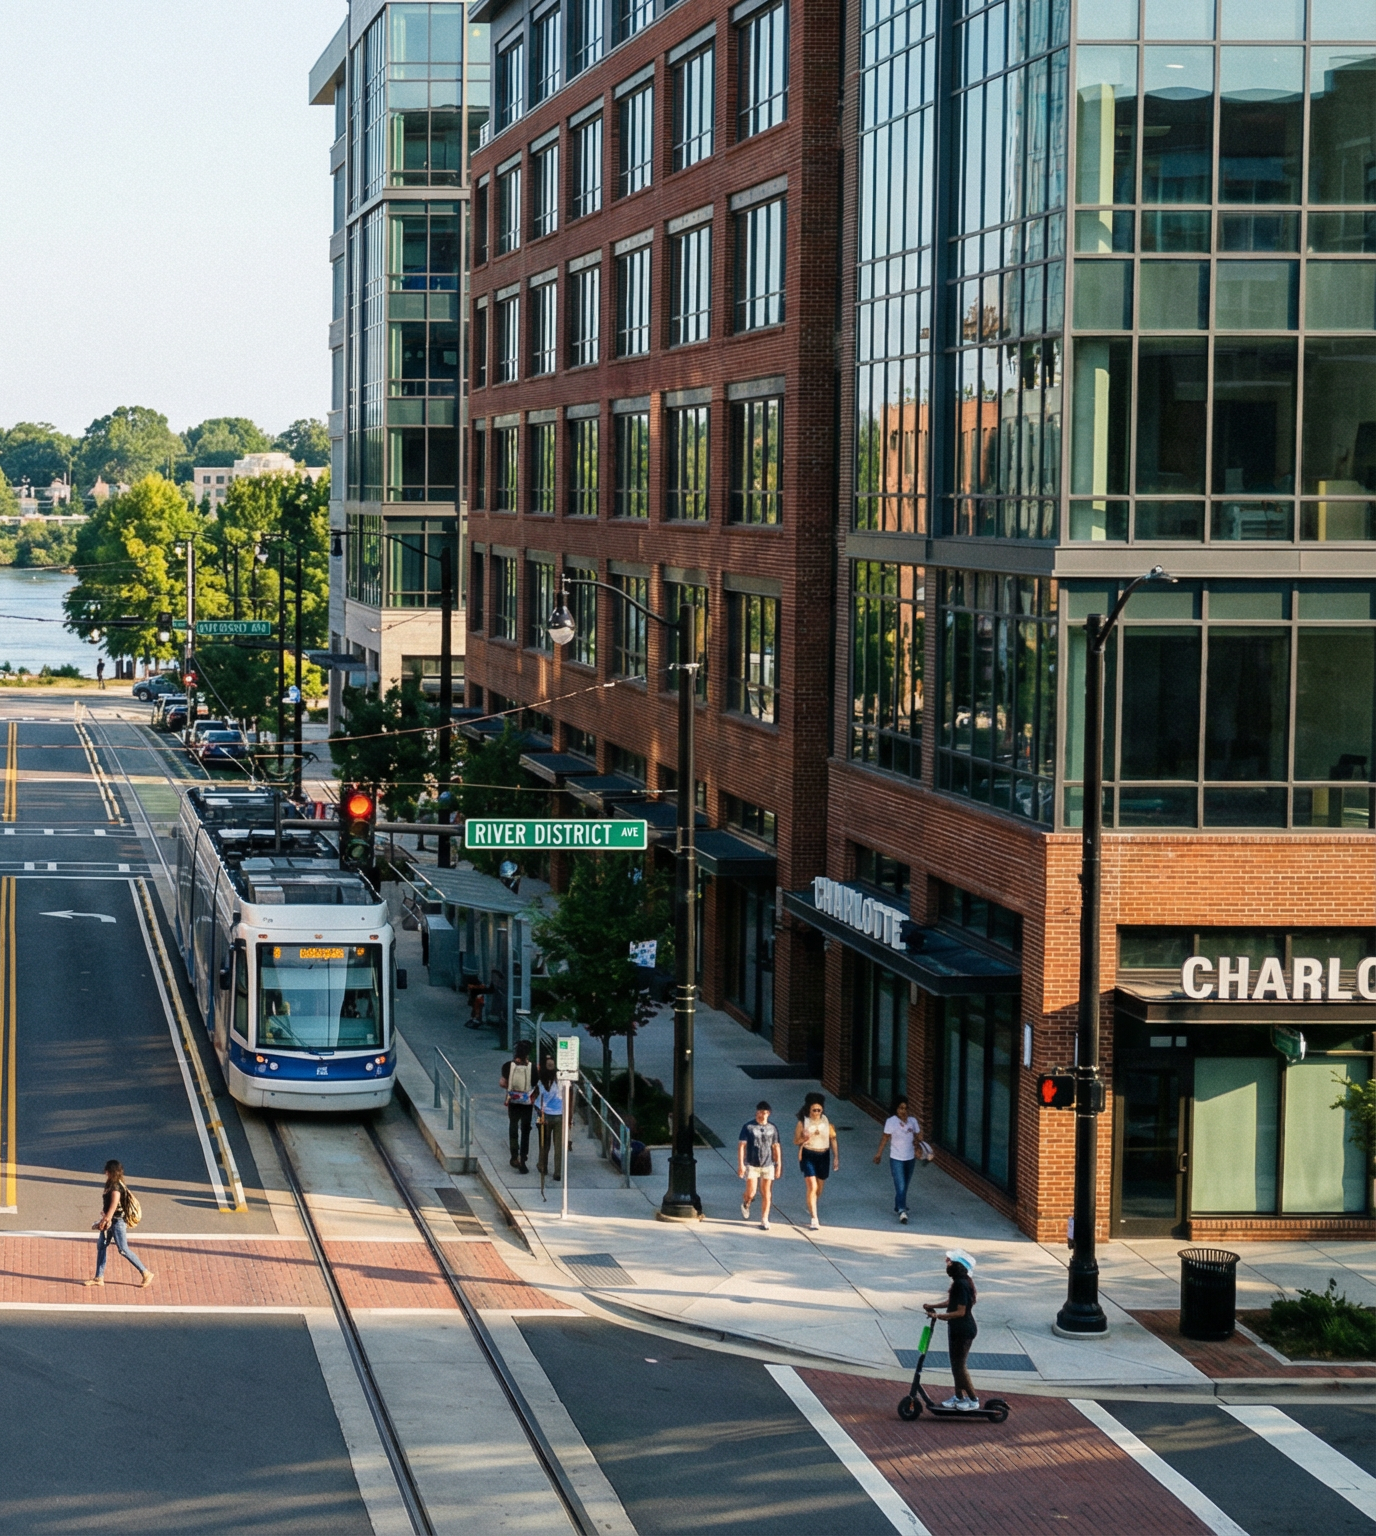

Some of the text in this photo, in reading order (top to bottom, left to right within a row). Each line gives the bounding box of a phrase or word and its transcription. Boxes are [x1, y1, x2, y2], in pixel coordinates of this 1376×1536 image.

[475, 823, 639, 844] RIVER DISTRICT AVE
